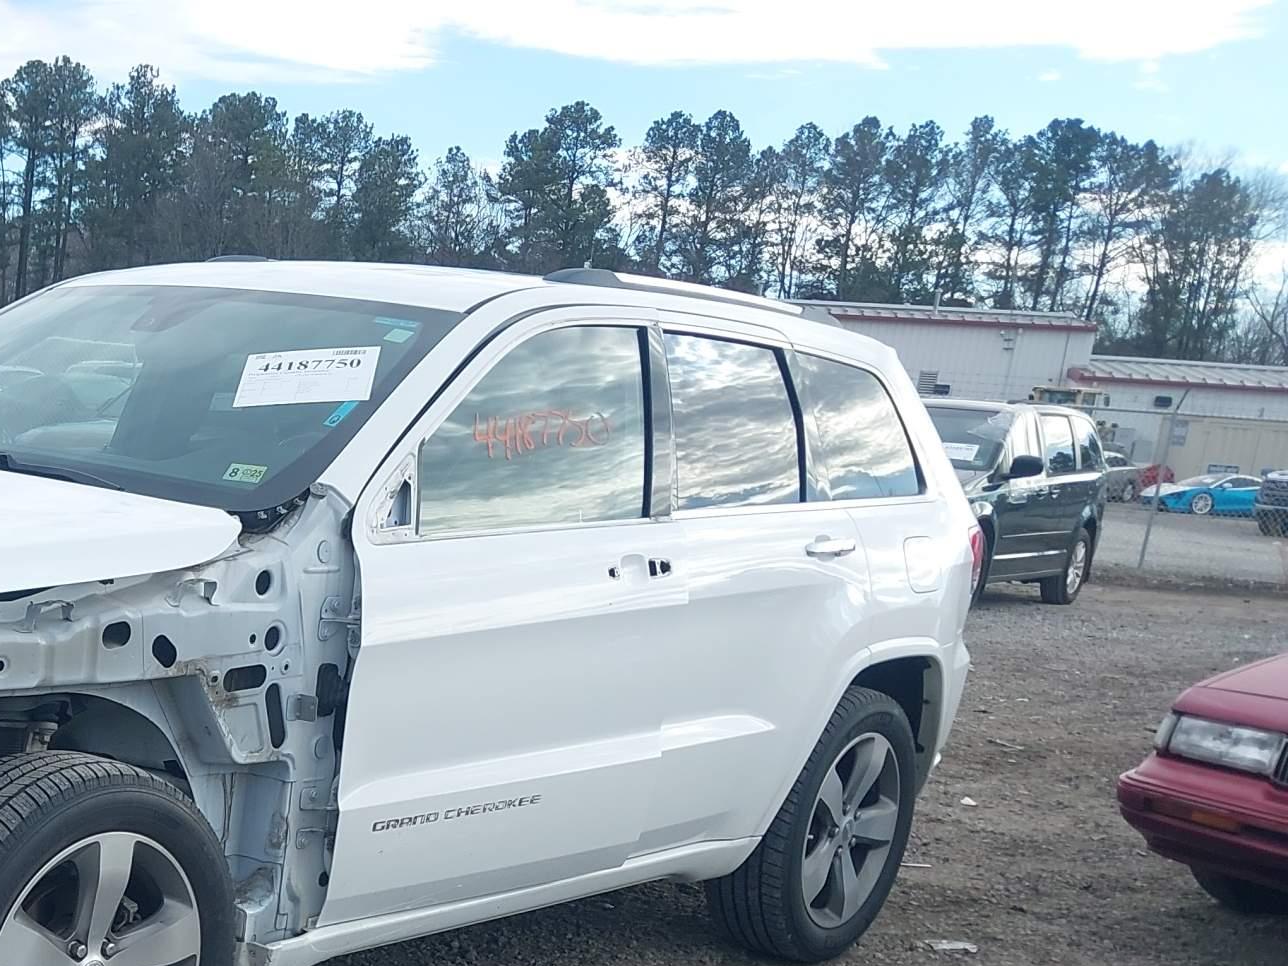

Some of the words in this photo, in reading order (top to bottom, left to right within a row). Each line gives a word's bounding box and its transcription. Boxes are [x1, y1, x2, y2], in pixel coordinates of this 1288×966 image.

[258, 357, 362, 373] 44187750
[473, 409, 610, 461] 44187750
[229, 467, 240, 478] 8
[371, 812, 439, 832] GRAND
[444, 794, 542, 820] CHEROKEE
